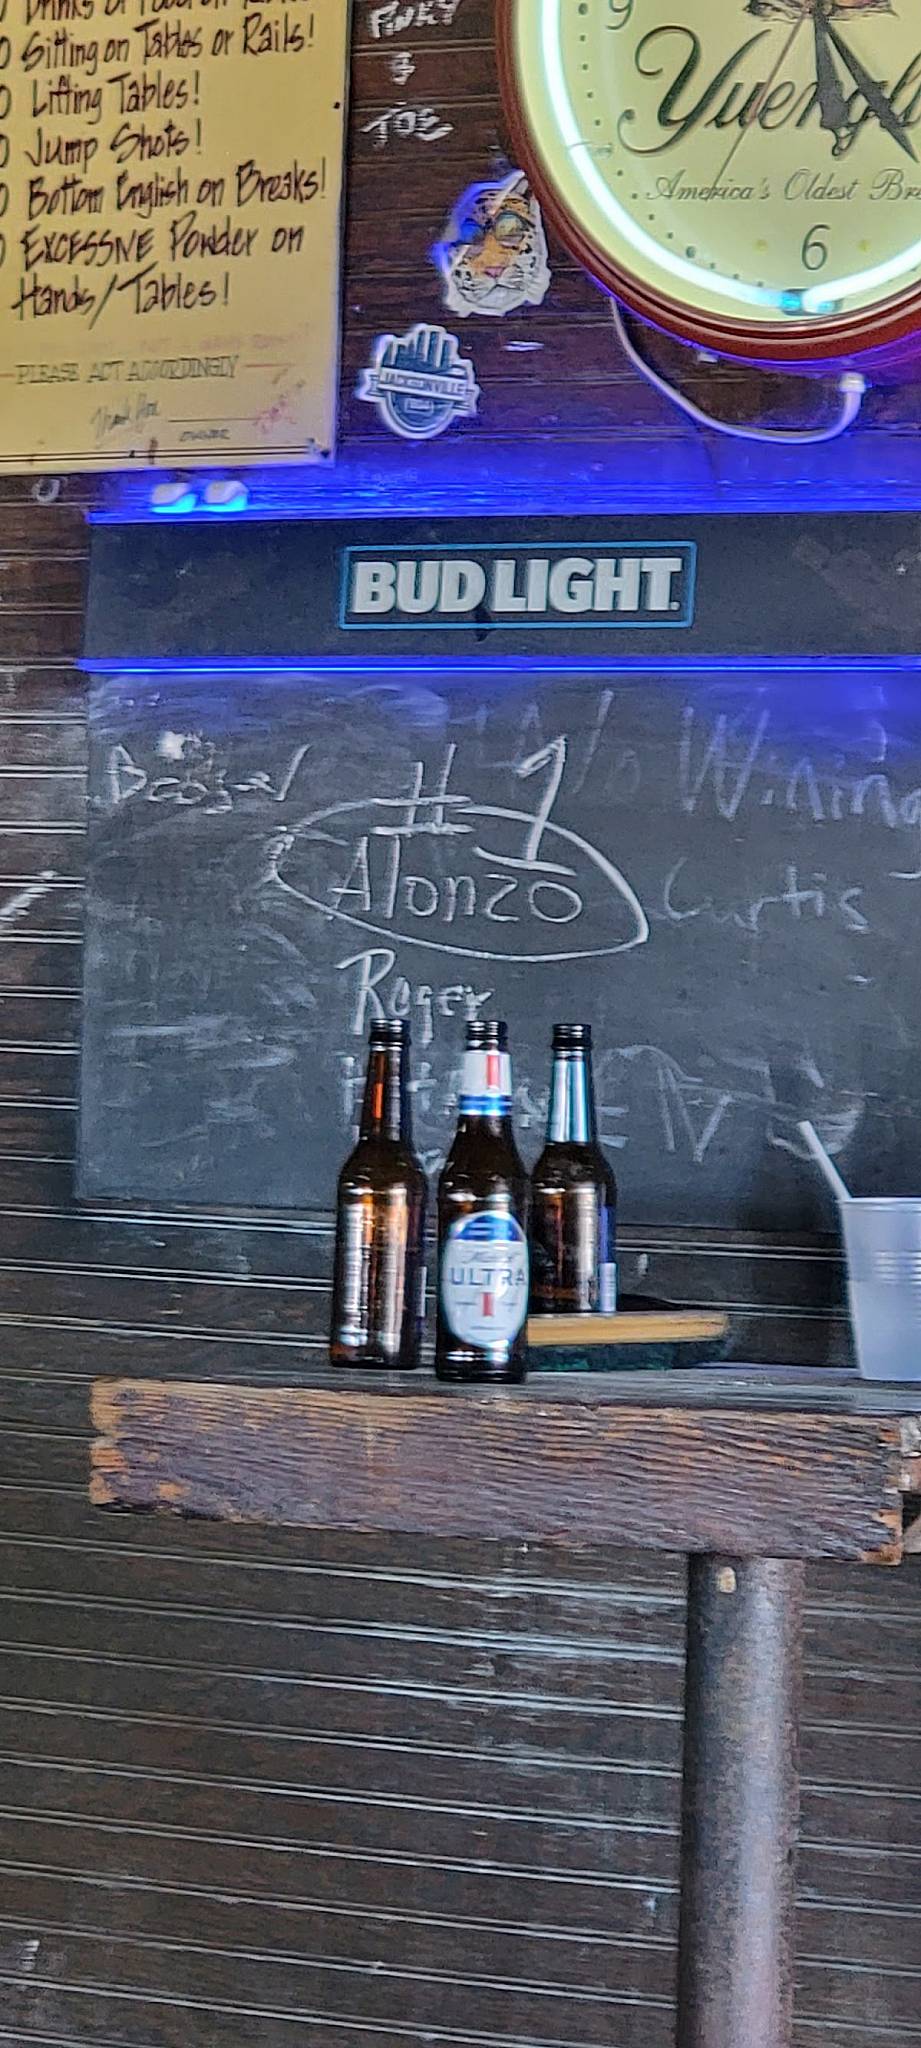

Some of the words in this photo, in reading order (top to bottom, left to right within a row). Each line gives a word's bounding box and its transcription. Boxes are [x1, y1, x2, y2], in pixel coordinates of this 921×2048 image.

[21, 27, 99, 76] Sitting
[104, 37, 129, 62] on
[133, 18, 202, 65] Tables
[211, 37, 235, 57] or
[243, 12, 314, 56] Rails!
[32, 75, 103, 124] Lifting
[106, 70, 200, 114] Tables!
[25, 127, 98, 174] Jump
[110, 118, 202, 164] Shots!
[28, 173, 104, 220] Bottom
[116, 166, 190, 219] English
[197, 178, 225, 206] on
[236, 156, 326, 208] Breaks!
[646, 169, 770, 200] America's
[785, 168, 859, 200] Oldest
[271, 225, 304, 253] on
[801, 224, 831, 270] 6
[15, 363, 79, 385] PLEASE
[87, 360, 124, 384] ACT
[126, 355, 239, 383] ACCORDINGLY
[352, 559, 486, 614] BUD
[326, 836, 583, 924] Alonzo
[448, 1266, 527, 1287] ULTRA
